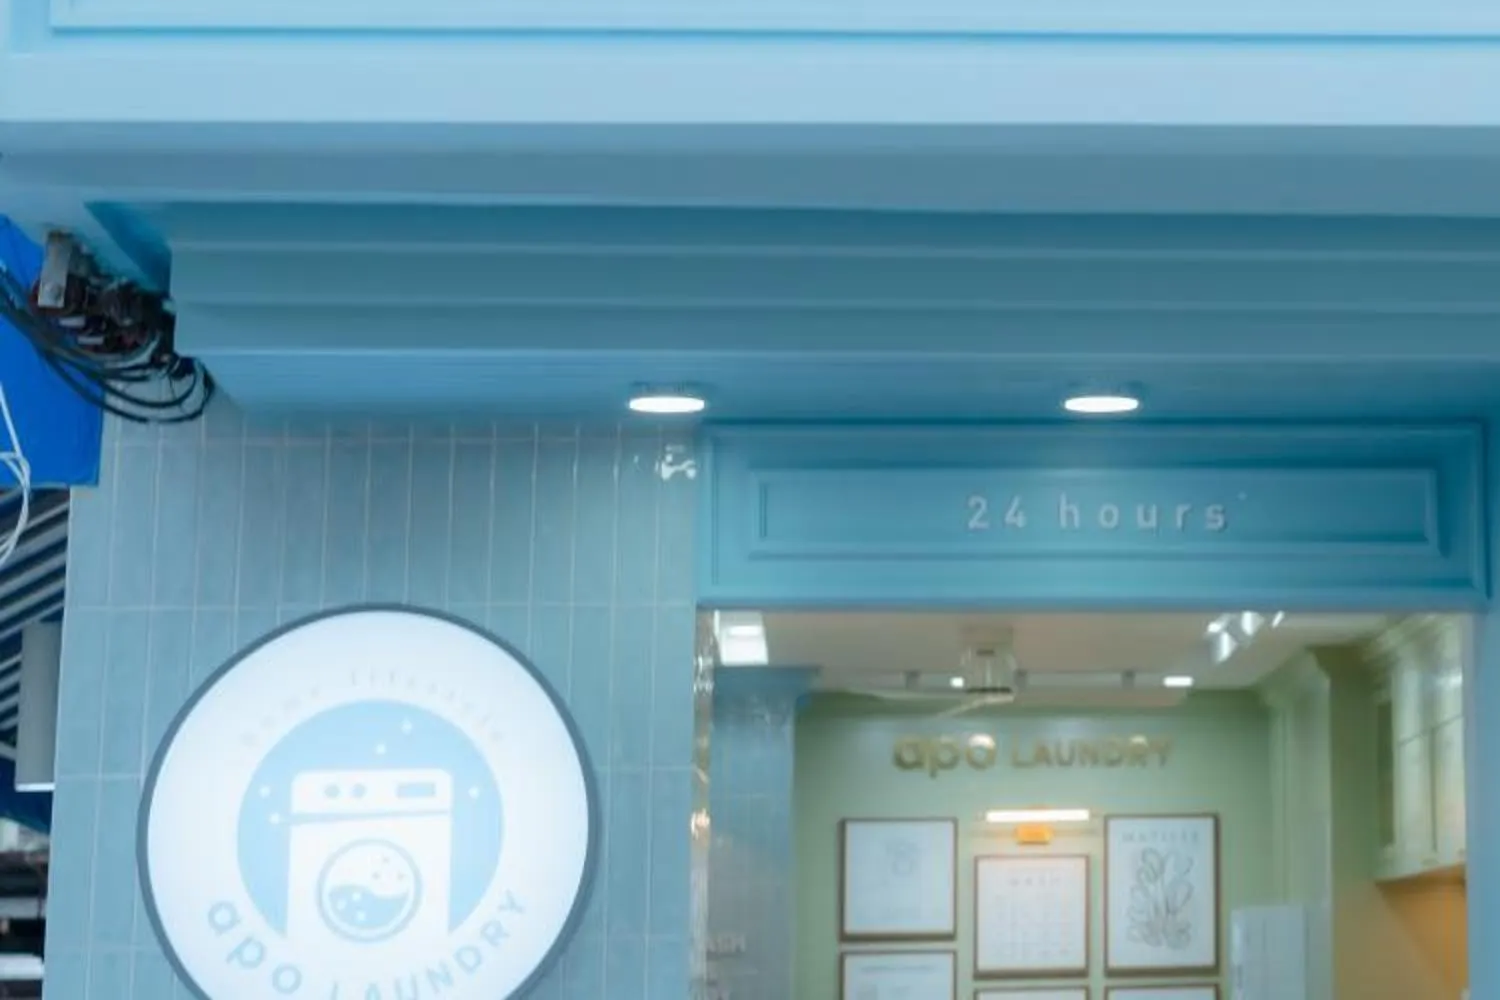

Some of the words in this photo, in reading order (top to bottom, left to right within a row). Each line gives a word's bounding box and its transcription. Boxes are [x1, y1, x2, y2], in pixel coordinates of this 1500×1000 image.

[967, 495, 1028, 530] 24
[1058, 492, 1227, 530] hours
[891, 732, 998, 779] apo
[1011, 737, 1173, 769] LAUNDRY
[207, 899, 303, 995] apo
